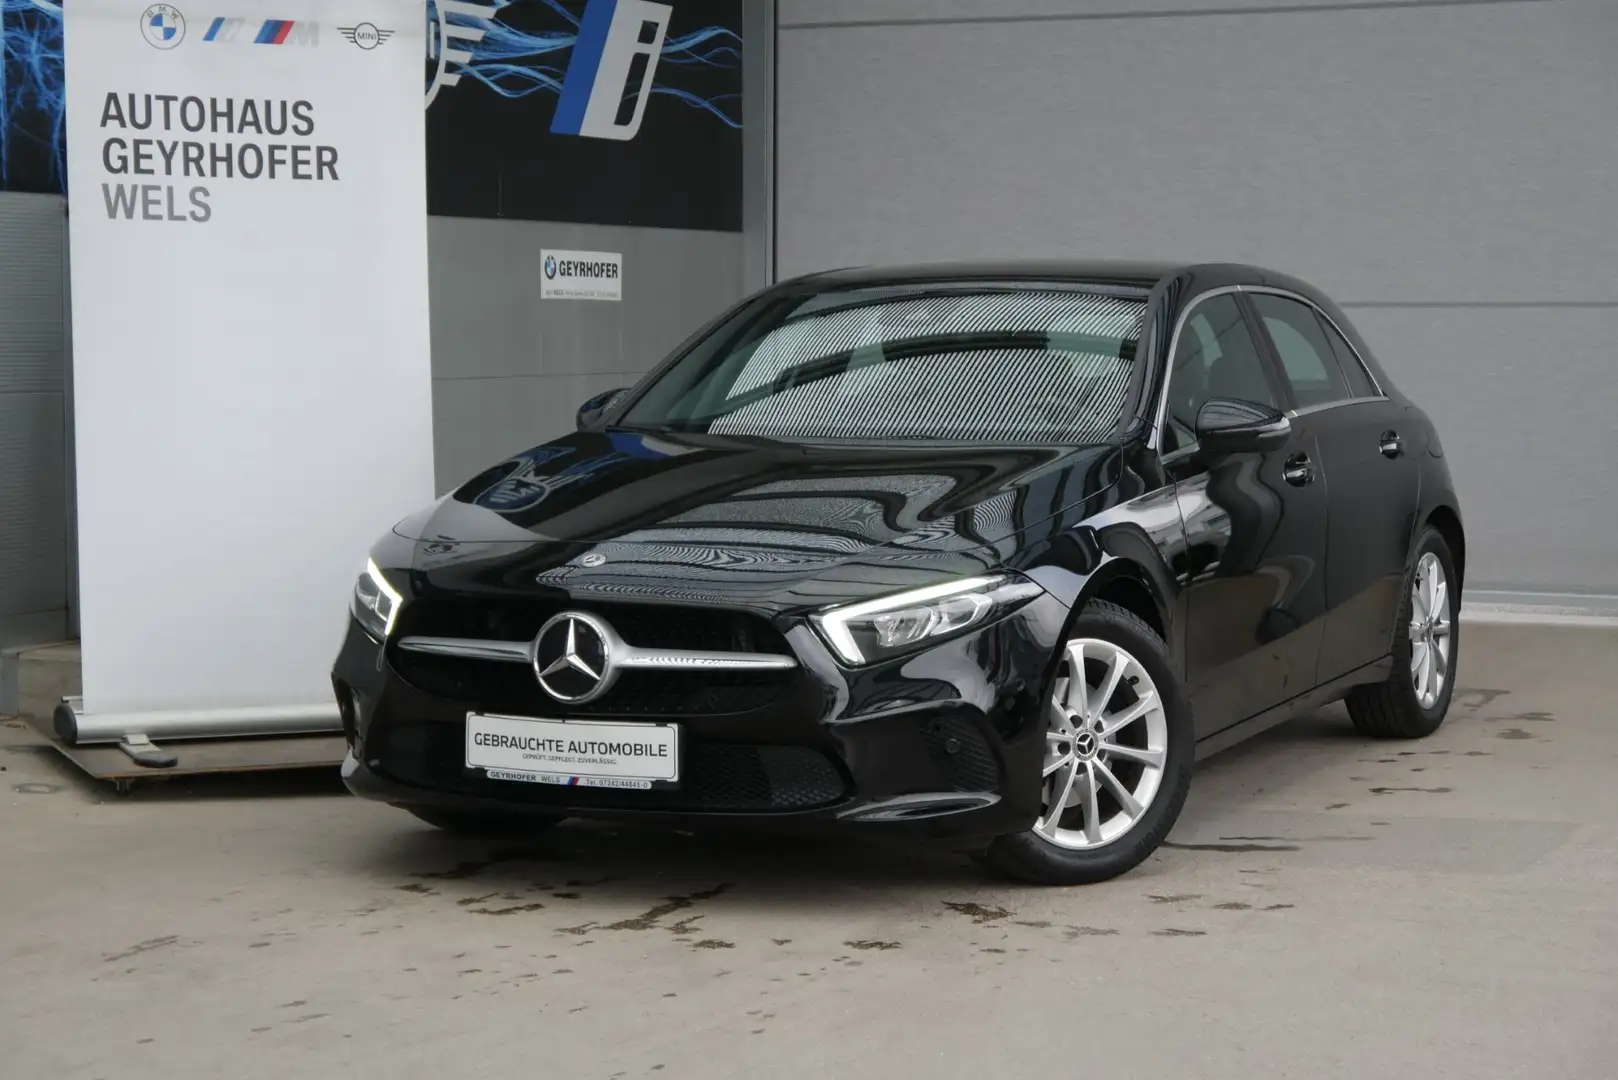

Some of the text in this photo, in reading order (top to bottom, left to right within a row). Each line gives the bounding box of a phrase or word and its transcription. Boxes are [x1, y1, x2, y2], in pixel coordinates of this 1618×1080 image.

[357, 31, 377, 40] MINI
[100, 92, 314, 136] AUTOHAUS
[102, 137, 340, 181] GEYRHOFER
[101, 183, 212, 223] WELS
[559, 260, 618, 279] GEYRHOFER
[474, 732, 668, 757] GEBRAUCHTE AUTOMOBILE
[490, 771, 536, 781] GEYRHOFER
[540, 775, 561, 784] WELS
